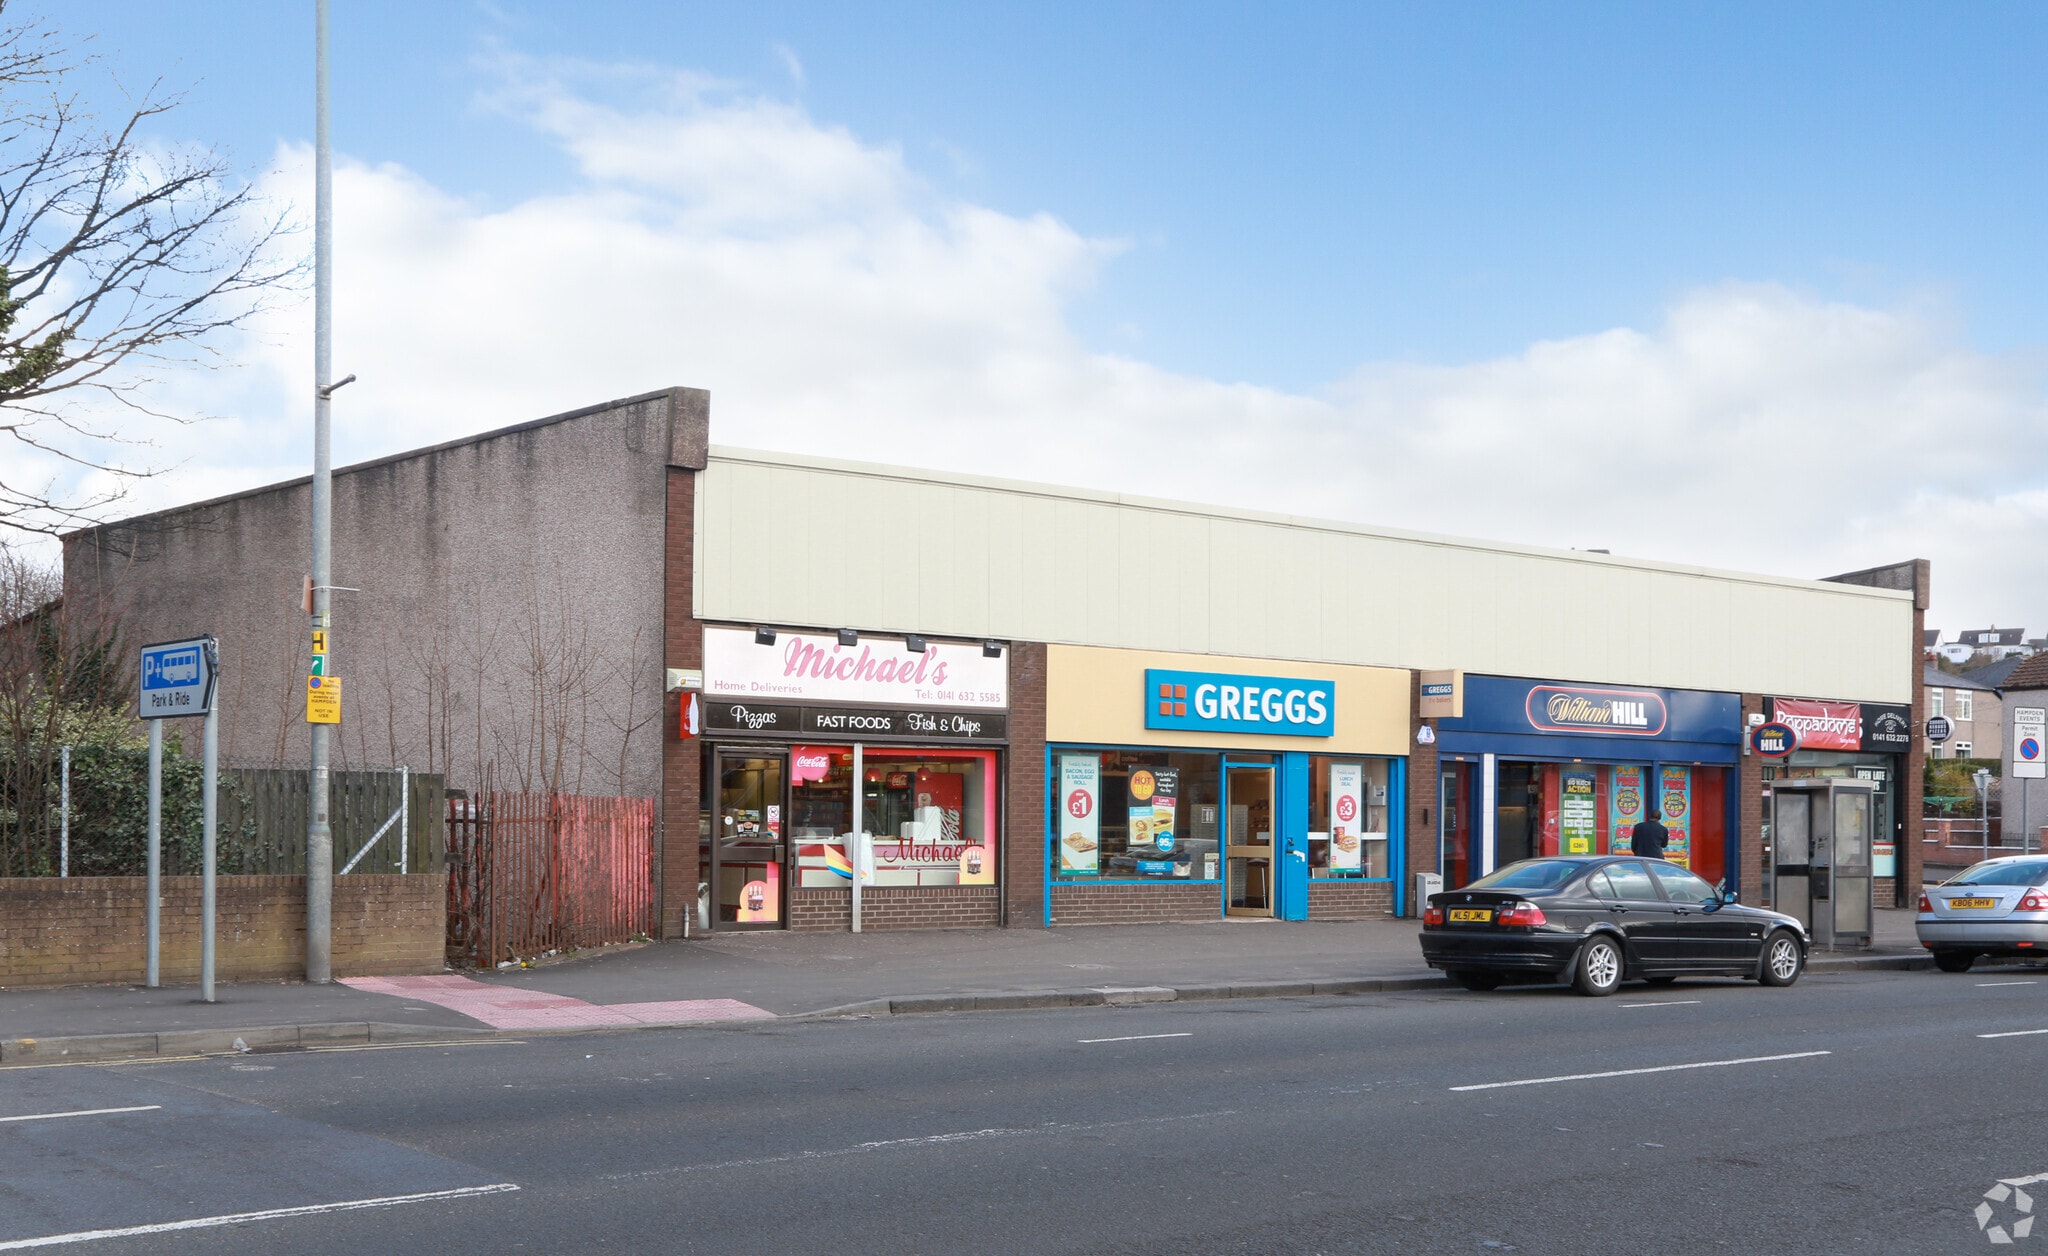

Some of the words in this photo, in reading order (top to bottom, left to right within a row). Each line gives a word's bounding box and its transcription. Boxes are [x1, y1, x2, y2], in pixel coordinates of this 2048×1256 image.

[784, 637, 948, 686] Michael's
[714, 680, 746, 690] Home
[751, 682, 802, 693] Deliveries
[1428, 686, 1452, 694] GREGGS
[152, 693, 167, 707] Park
[169, 693, 173, 706] &
[176, 692, 190, 705] Ride
[915, 690, 932, 699] Tel:
[938, 690, 954, 700] 0141
[959, 691, 975, 701] 632
[979, 693, 1000, 702] 5585
[1195, 684, 1327, 725] GREGGS
[1547, 694, 1614, 724] William
[1612, 701, 1647, 725] HILL
[730, 705, 776, 728] Pizzas
[817, 715, 846, 728] FAST
[849, 716, 891, 730] FOODS
[1776, 708, 1856, 737] Poppadoms
[908, 713, 936, 731] Fish
[940, 719, 948, 730] &
[952, 715, 980, 737] Chips
[1761, 739, 1785, 751] HILL
[1616, 766, 1639, 775] PLAY
[1663, 770, 1685, 779] PLAY
[1857, 770, 1871, 779] OPEN
[1873, 770, 1885, 780] LATE
[1135, 776, 1151, 784] HOT
[1072, 796, 1087, 814] £1
[1340, 802, 1352, 816] £3
